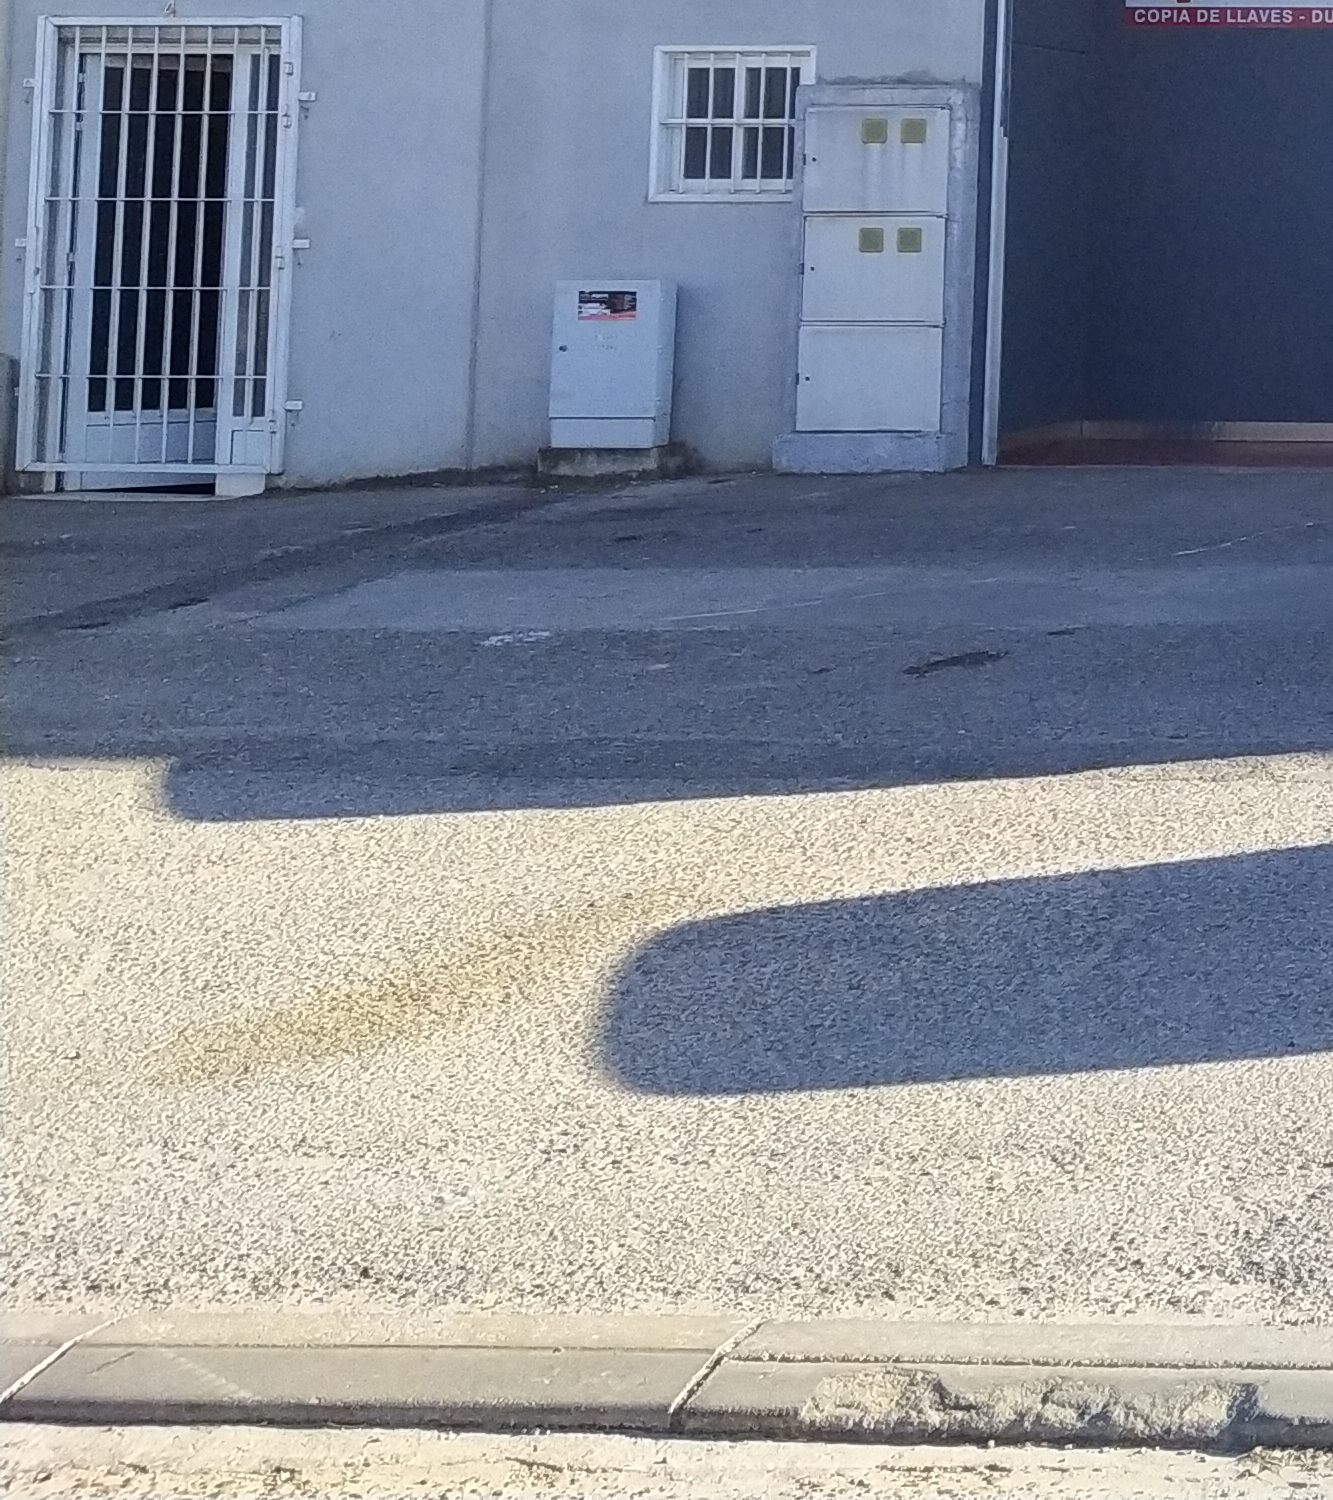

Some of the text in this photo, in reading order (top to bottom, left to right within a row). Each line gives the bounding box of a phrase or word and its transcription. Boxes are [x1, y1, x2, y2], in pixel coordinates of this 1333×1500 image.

[1134, 9, 1191, 23] COPIA
[1196, 9, 1220, 23] DE
[1226, 9, 1293, 23] LLAVES
